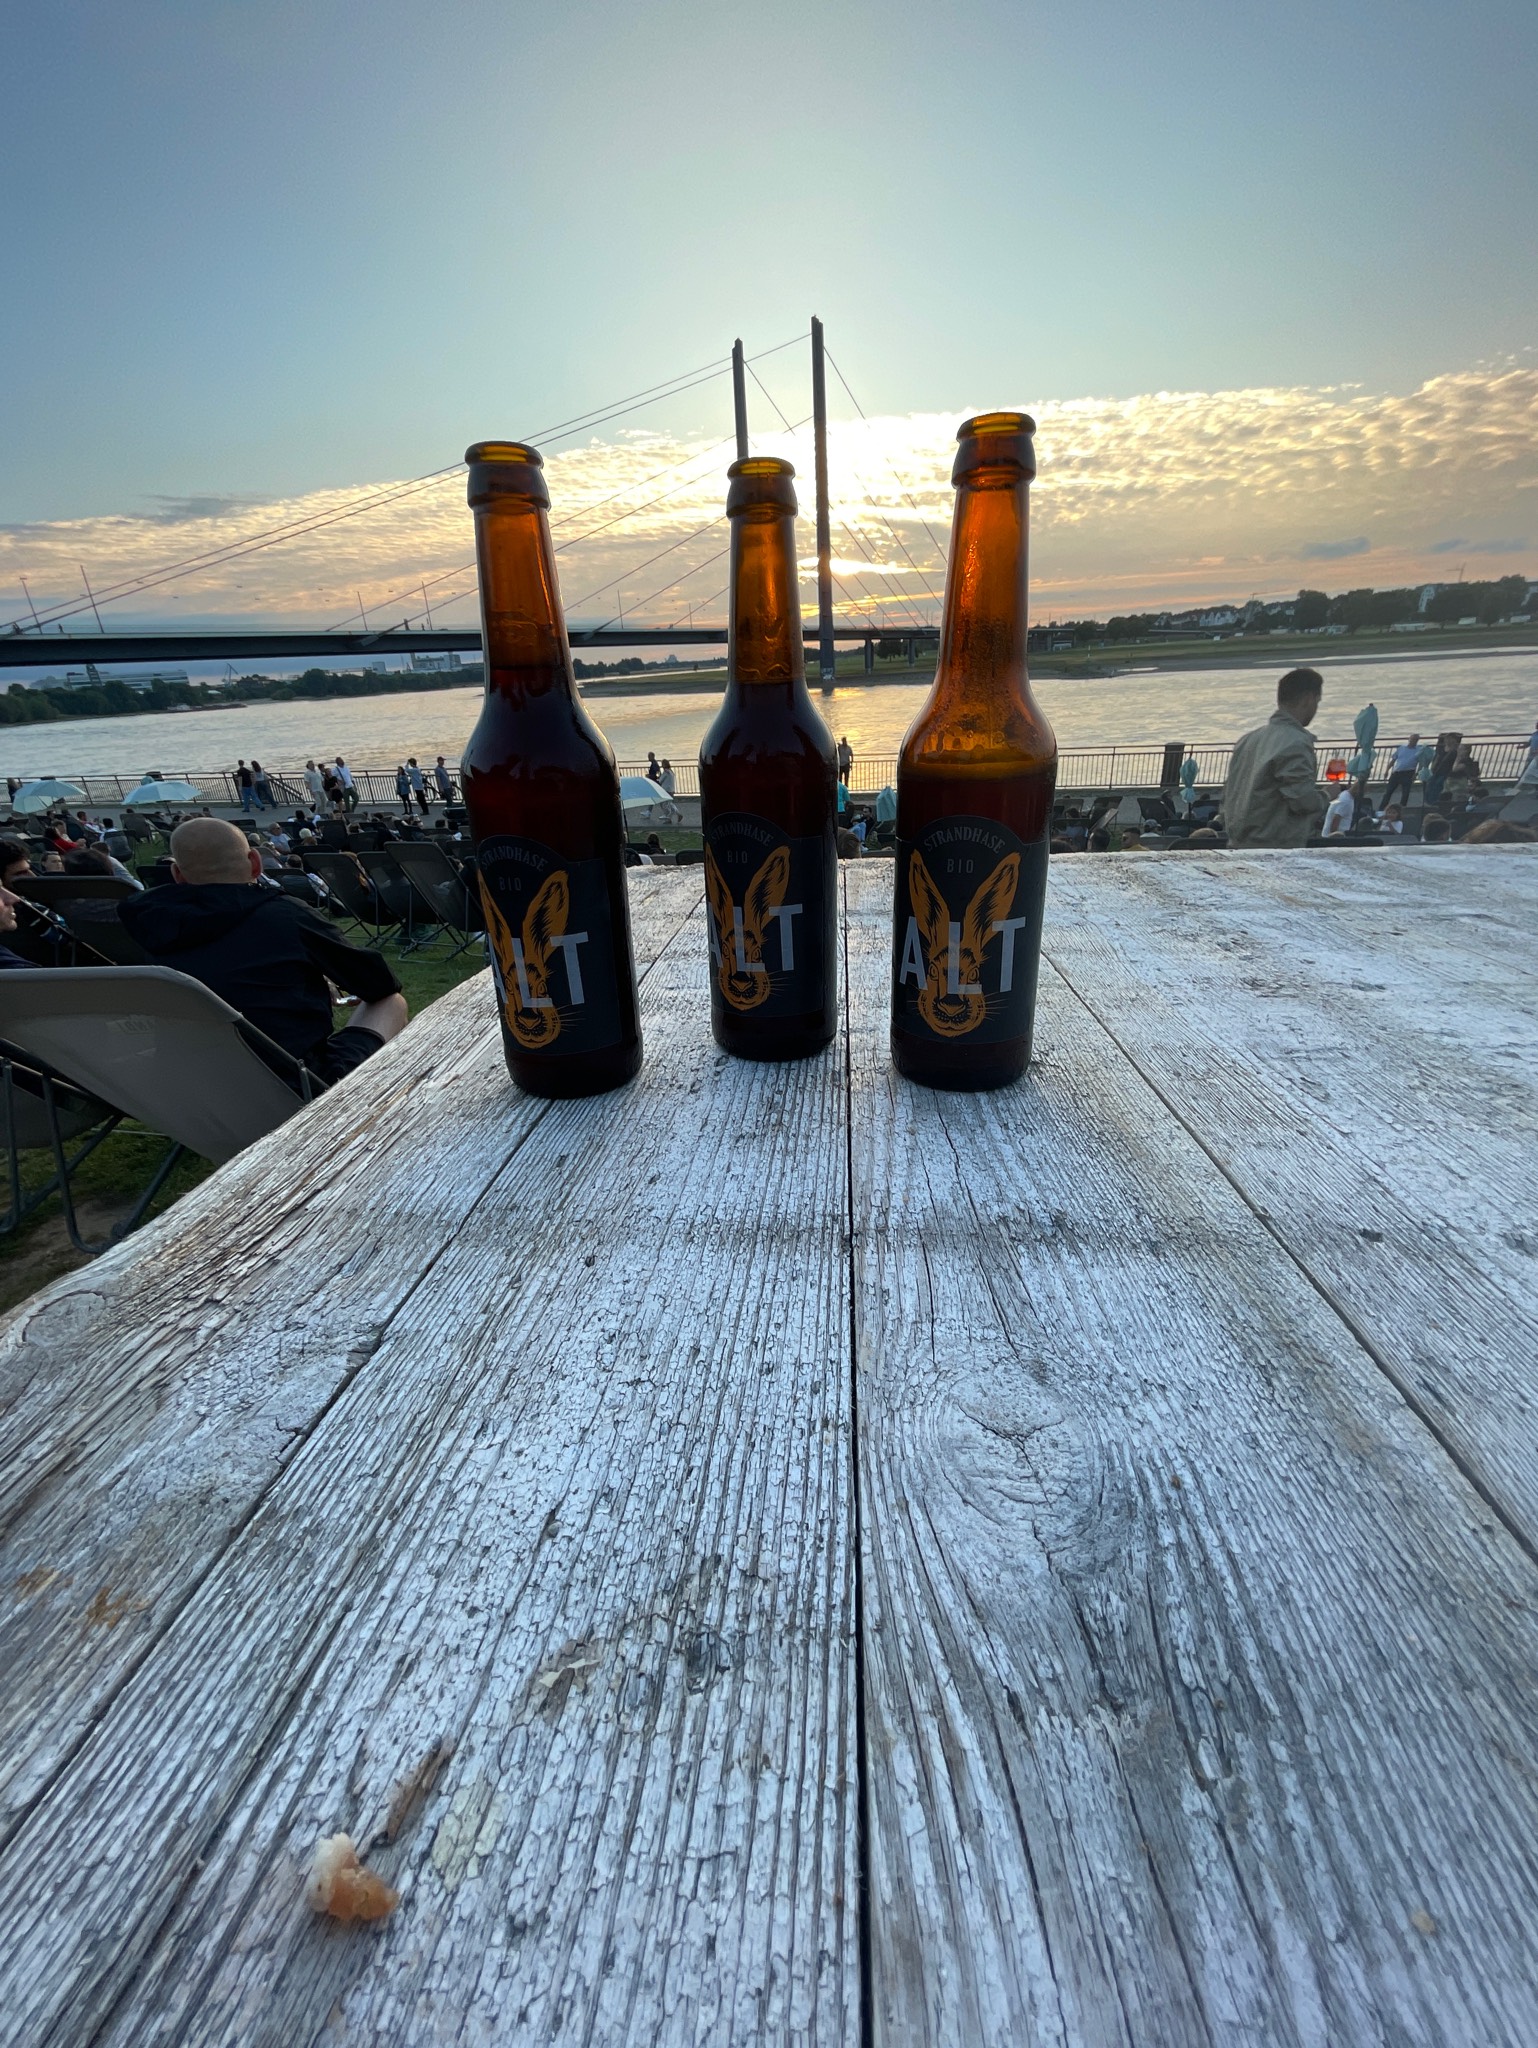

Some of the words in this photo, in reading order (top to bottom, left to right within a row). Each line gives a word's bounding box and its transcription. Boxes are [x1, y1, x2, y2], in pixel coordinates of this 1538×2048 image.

[710, 821, 774, 848] STRANDHASE
[923, 826, 1006, 854] STRANDHASE
[481, 845, 549, 872] STRANDHASE
[727, 850, 748, 864] BIO
[947, 859, 974, 873] BIO
[499, 876, 522, 891] BIO
[899, 916, 1026, 995] ALT
